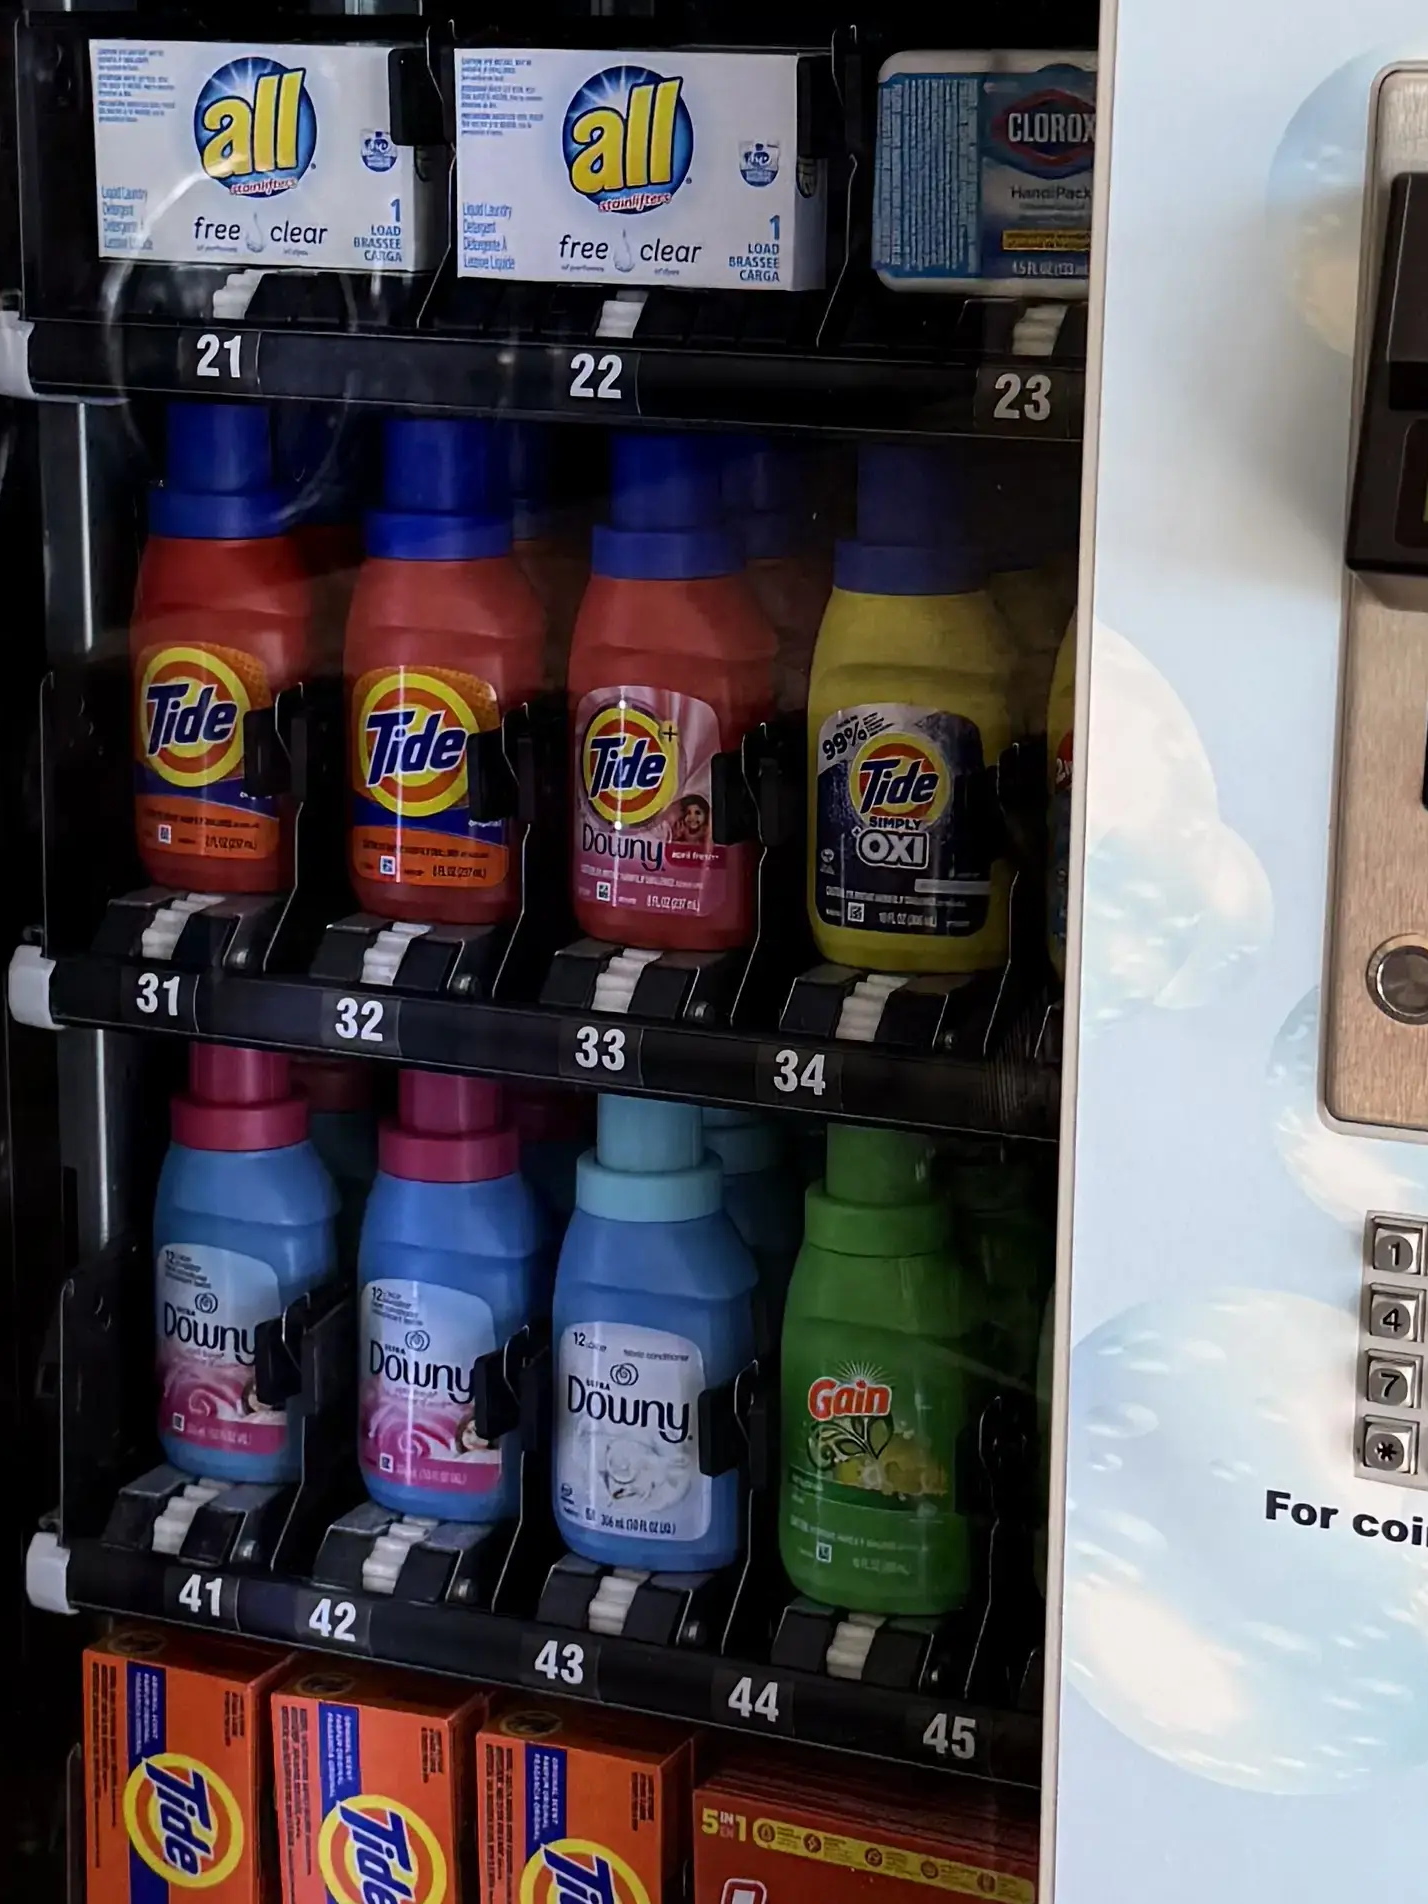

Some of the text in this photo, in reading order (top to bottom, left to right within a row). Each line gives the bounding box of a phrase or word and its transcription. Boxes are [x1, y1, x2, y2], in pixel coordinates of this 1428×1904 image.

[203, 68, 306, 178] all
[571, 77, 683, 194] all
[1008, 112, 1096, 143] CLOROX
[229, 176, 299, 196] stainlifters
[598, 192, 672, 213] stainlifters
[194, 217, 328, 245] free clear
[371, 225, 402, 237] LOAD
[390, 198, 401, 222] 1
[770, 215, 780, 240] 1
[353, 237, 402, 250] BRASSEE
[364, 249, 402, 263] CARGA
[559, 233, 702, 265] free clear
[728, 256, 780, 269] BRASSEE
[747, 242, 780, 256] LOAD
[739, 269, 780, 283] CARGA
[196, 333, 242, 378] 21
[570, 352, 623, 399] 22
[993, 373, 1051, 421] 23
[145, 682, 238, 757] Tide
[822, 721, 867, 760] 99%
[365, 710, 468, 788] Tide
[589, 734, 667, 799] Tide
[860, 758, 940, 814] Tide
[869, 817, 922, 831] SIMPLY
[582, 824, 666, 871] Downy
[858, 829, 929, 869] OXI
[136, 973, 180, 1016] 31
[335, 997, 384, 1042] 32
[575, 1025, 626, 1072] 33
[774, 1049, 826, 1096] 34
[1389, 1241, 1404, 1268] 1
[372, 1287, 382, 1301] 12
[164, 1301, 256, 1366] Downy
[573, 1332, 586, 1347] 12
[1382, 1305, 1404, 1335] 4
[369, 1340, 475, 1405] Downy
[1380, 1372, 1399, 1400] 7
[567, 1375, 690, 1444] Downy
[808, 1376, 893, 1422] Gain
[1264, 1489, 1339, 1534] For
[179, 1574, 224, 1617] 41
[309, 1599, 357, 1642] 42
[534, 1639, 585, 1686] 43
[728, 1677, 779, 1723] 44
[923, 1713, 976, 1761] 45
[141, 1757, 216, 1878] Tide
[702, 1807, 747, 1841] 5 IN 1
